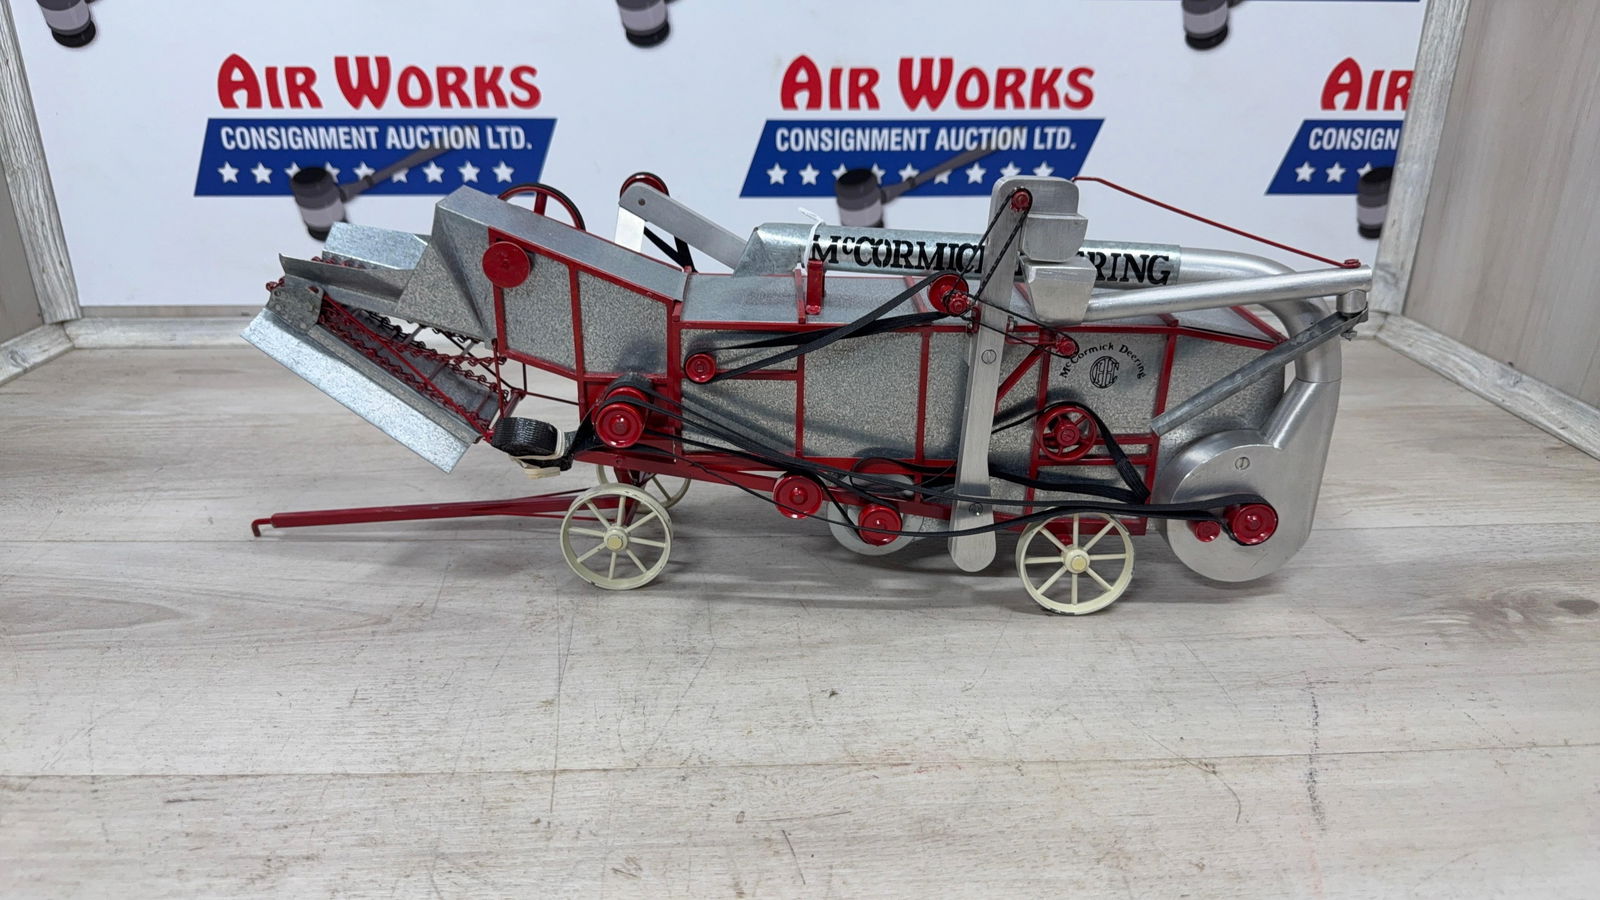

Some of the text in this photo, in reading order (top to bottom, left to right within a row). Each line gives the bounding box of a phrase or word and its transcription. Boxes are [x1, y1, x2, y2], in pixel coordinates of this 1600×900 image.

[217, 53, 541, 109] AIR WORKS
[780, 54, 1094, 111] AIR WORKS
[1320, 57, 1414, 111] AIR
[220, 126, 533, 150] CONSIGNMENT AUCTION LTD.
[775, 127, 1077, 152] CONSIGNMENT AUCTION LTD.
[1118, 344, 1147, 380] Deering
